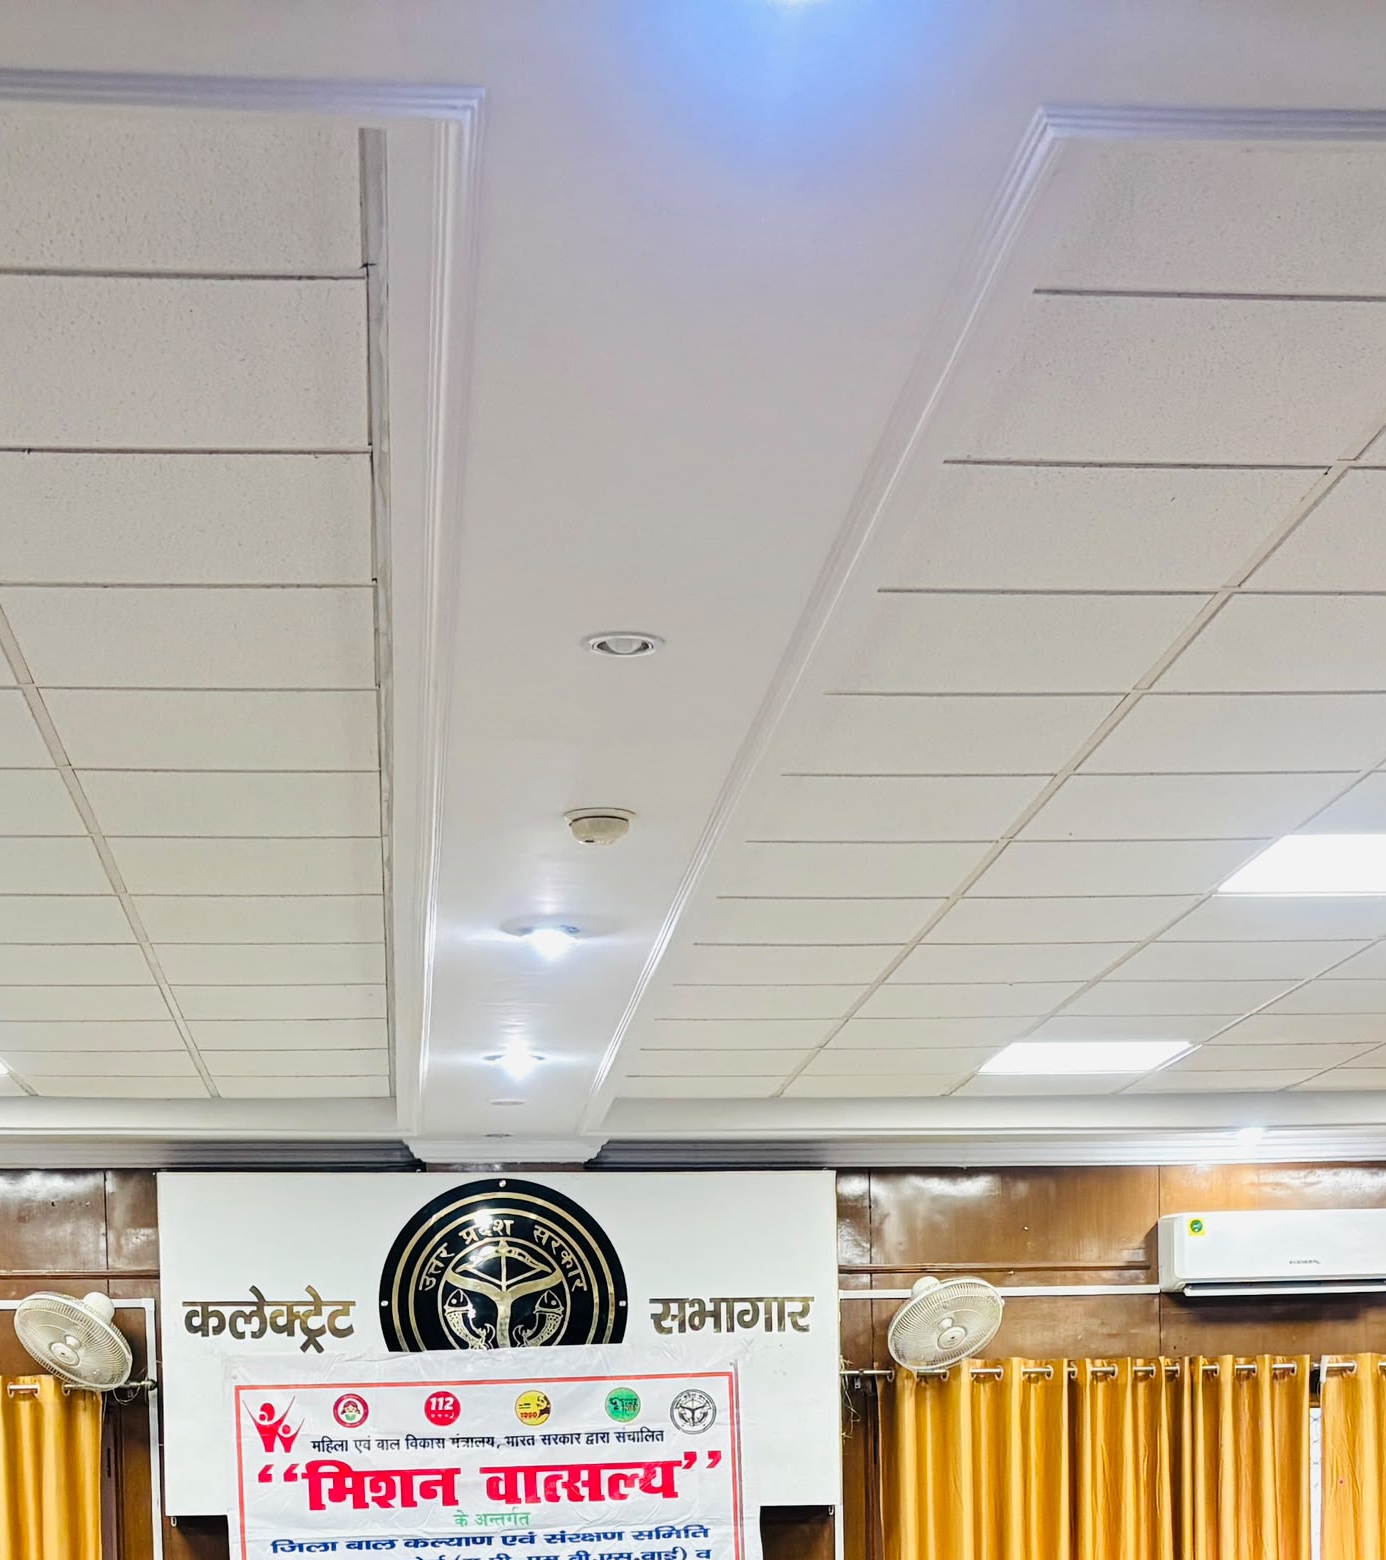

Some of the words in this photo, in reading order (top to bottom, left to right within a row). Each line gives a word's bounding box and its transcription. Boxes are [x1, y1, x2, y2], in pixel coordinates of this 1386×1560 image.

[532, 1225, 588, 1292] सरकार
[182, 1285, 356, 1353] कलेक्ट्रेट
[649, 1297, 814, 1335] सभागार
[429, 1396, 454, 1411] 112
[311, 1435, 349, 1453] महिला
[353, 1435, 371, 1454] एवं
[405, 1433, 446, 1450] विकास
[450, 1433, 501, 1449] मंत्रालय,
[540, 1432, 581, 1446] सरकार
[584, 1431, 610, 1445] द्वारा
[614, 1426, 664, 1443] संचालित
[453, 1509, 469, 1527] के
[474, 1506, 531, 1527] अन्तर्गत
[271, 1539, 338, 1554] जिला
[345, 1539, 398, 1551] बाल
[402, 1535, 494, 1549] कल्याण
[500, 1531, 536, 1546] एवं
[544, 1530, 624, 1544] संरक्षण
[631, 1524, 711, 1541] समिति
[695, 1549, 712, 1559] व
